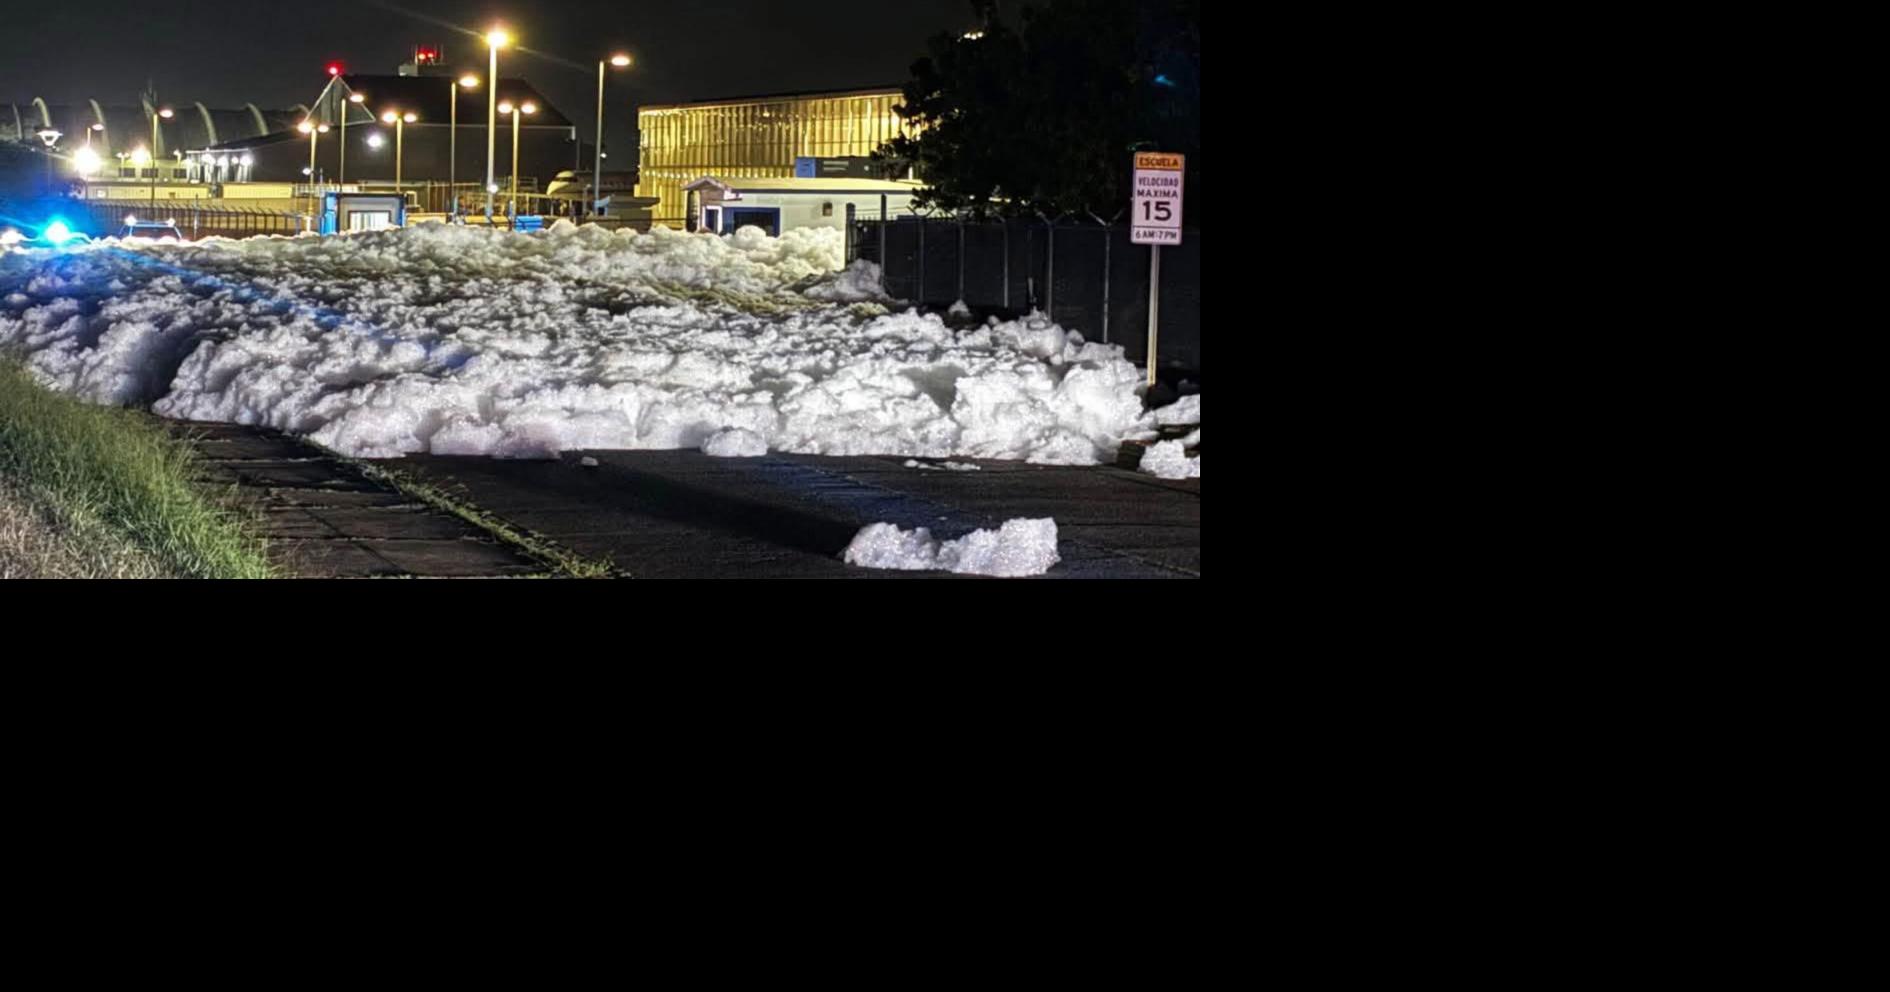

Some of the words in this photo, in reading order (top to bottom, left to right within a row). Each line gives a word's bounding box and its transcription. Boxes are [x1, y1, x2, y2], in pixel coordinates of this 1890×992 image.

[1139, 157, 1178, 167] ESCUELA
[1138, 177, 1179, 187] VELOCIDAD
[1143, 200, 1172, 221] 15
